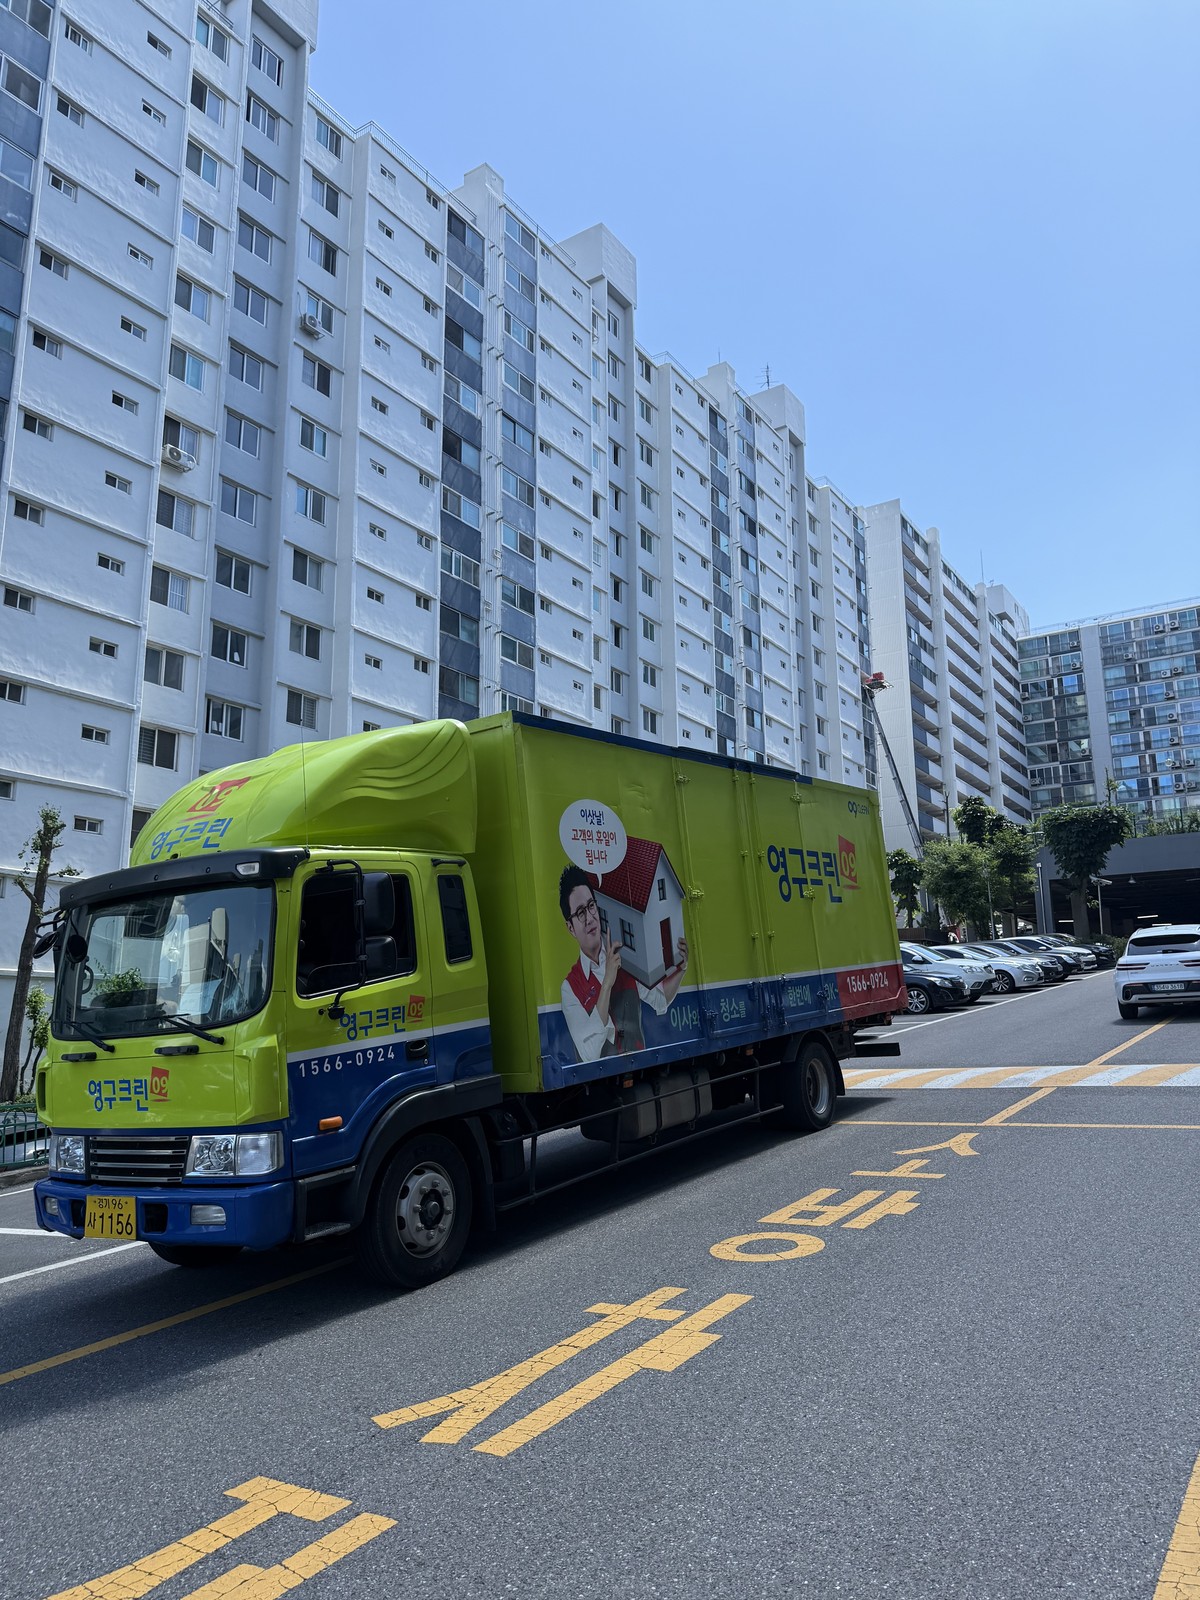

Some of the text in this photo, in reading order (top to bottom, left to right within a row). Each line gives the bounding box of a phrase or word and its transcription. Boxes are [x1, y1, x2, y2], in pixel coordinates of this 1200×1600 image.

[580, 808, 605, 826] 이삿날!
[150, 817, 233, 860] 영구크린
[571, 828, 617, 847] 고객의 휴일이
[585, 849, 607, 866] 됩니다
[767, 845, 857, 903] 영구크린 09
[846, 971, 889, 993] 1566-0924
[720, 997, 747, 1023] 청소를
[787, 983, 812, 1007] 한번에
[340, 1001, 424, 1041] 영구크린 09
[299, 1045, 395, 1078] 1566-0924
[88, 1076, 168, 1112] 영구크린 09
